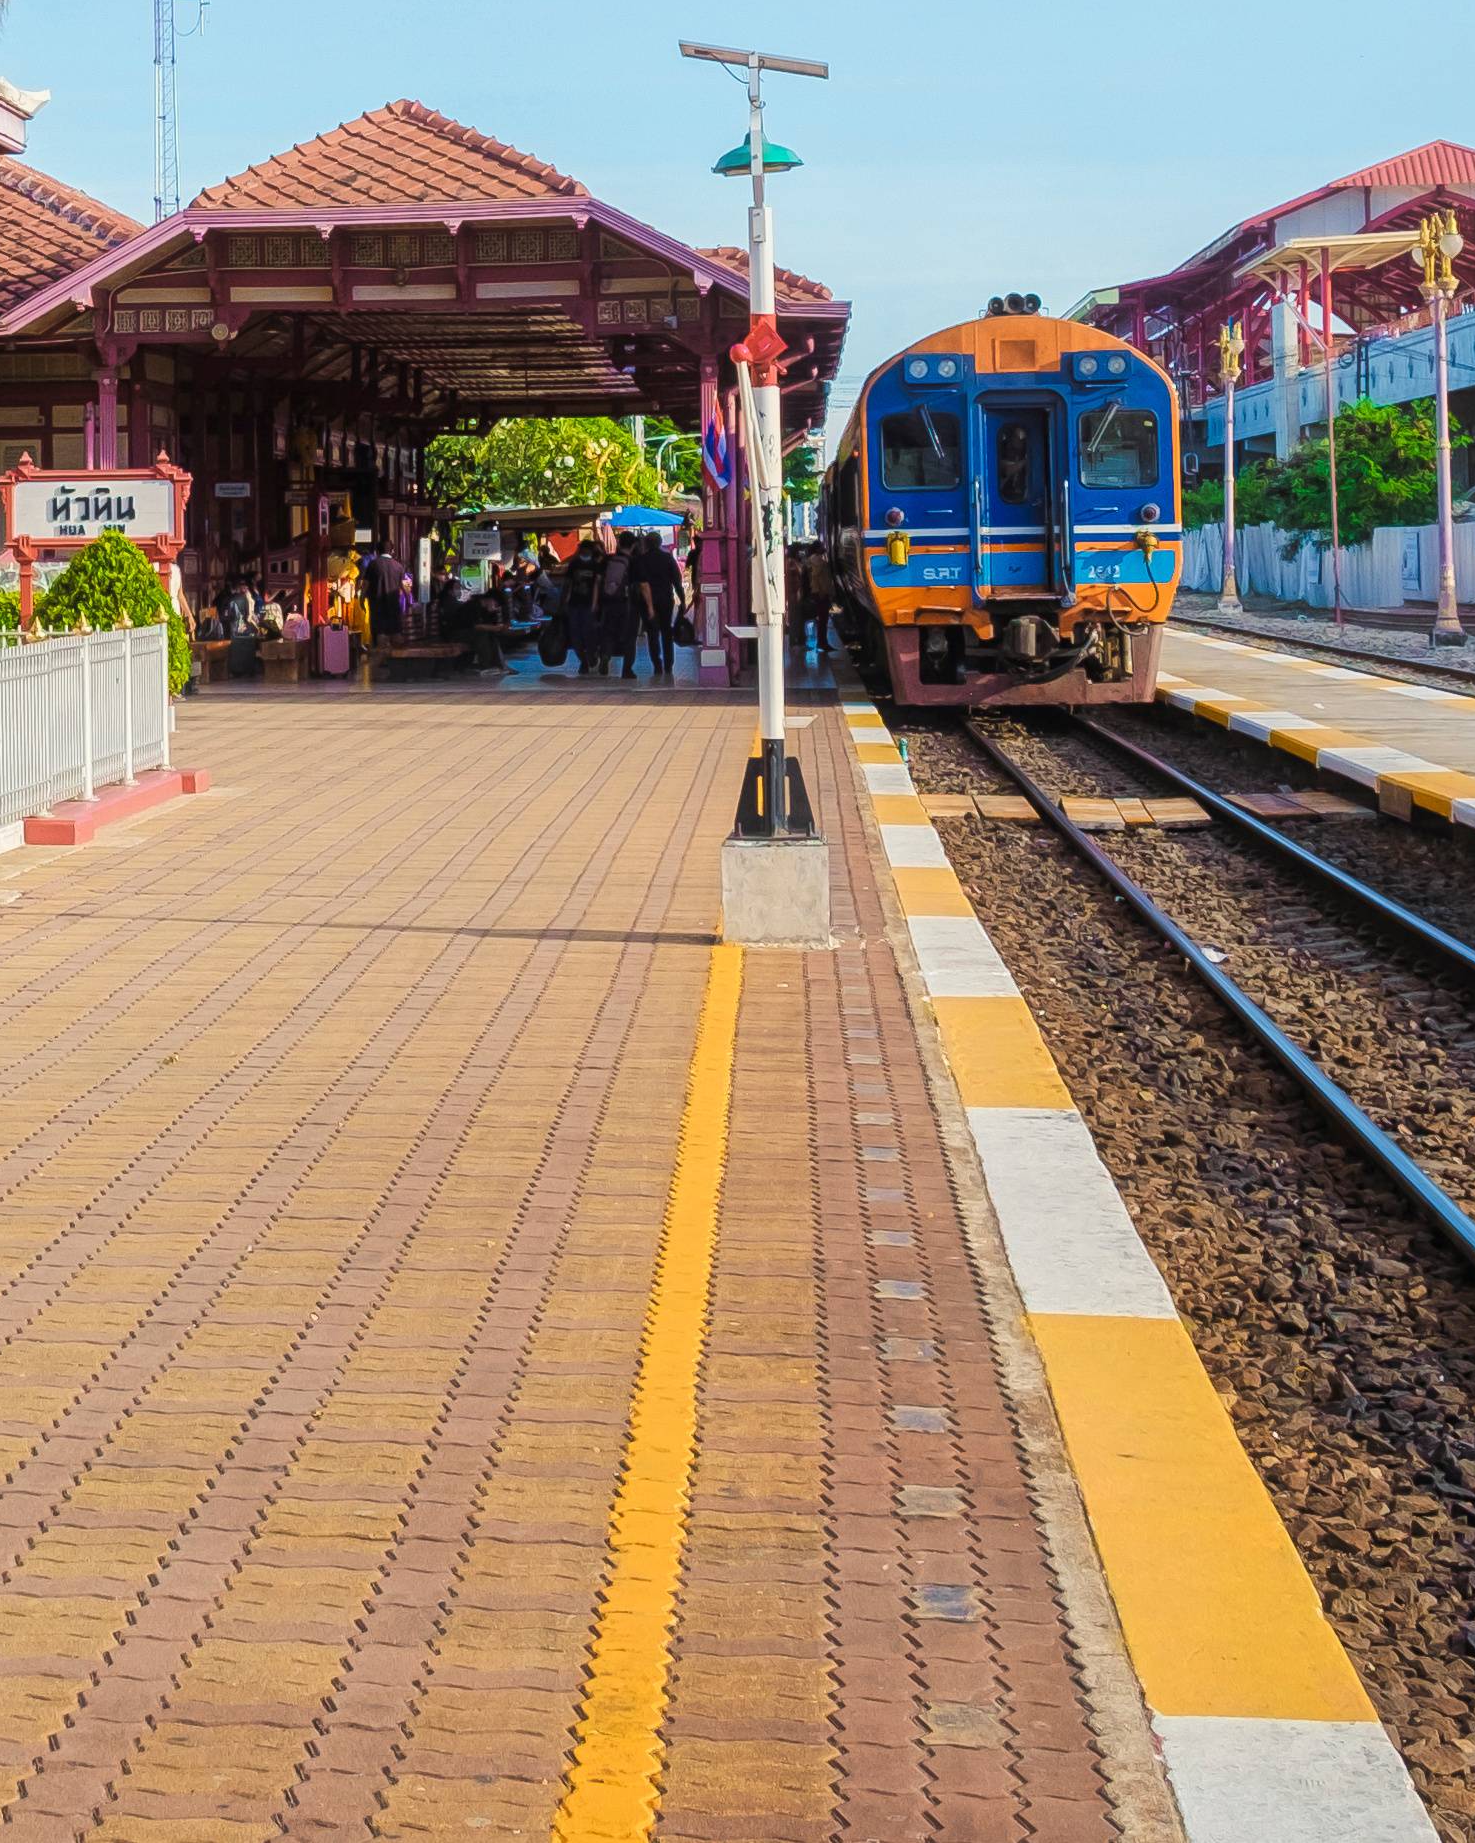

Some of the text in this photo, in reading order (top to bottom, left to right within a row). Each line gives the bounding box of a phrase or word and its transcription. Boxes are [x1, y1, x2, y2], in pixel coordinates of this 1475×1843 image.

[52, 485, 136, 521] หัวหิน
[60, 524, 86, 535] HUA
